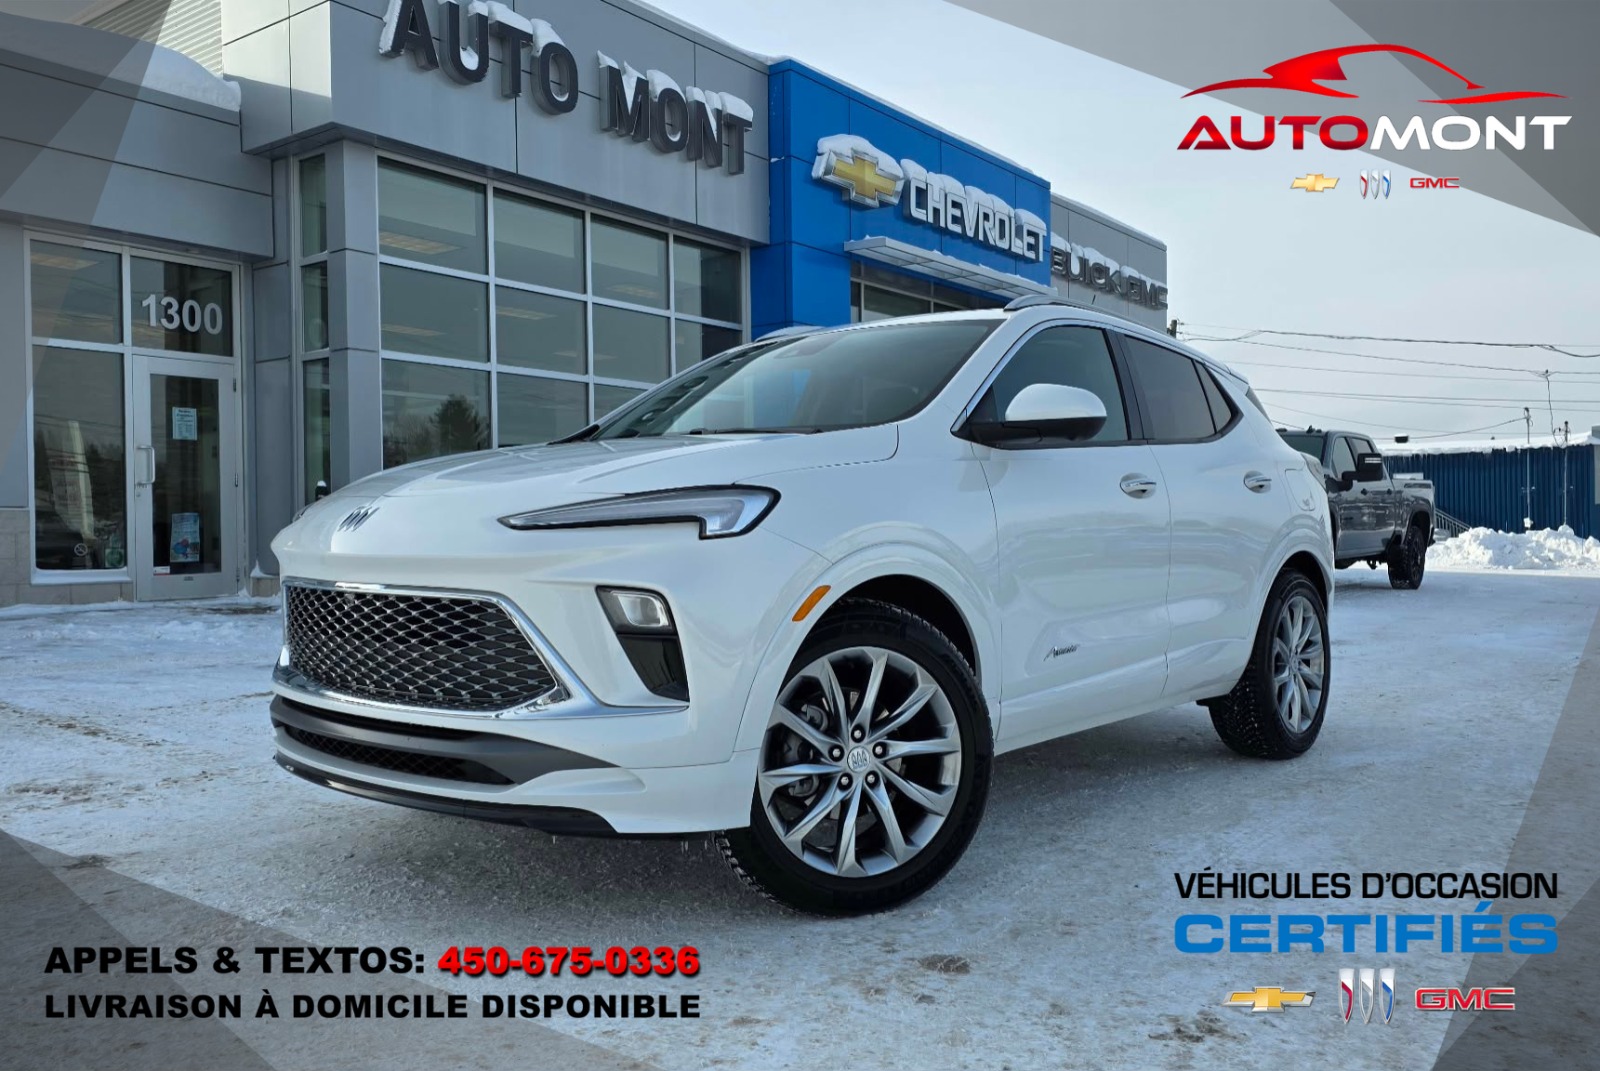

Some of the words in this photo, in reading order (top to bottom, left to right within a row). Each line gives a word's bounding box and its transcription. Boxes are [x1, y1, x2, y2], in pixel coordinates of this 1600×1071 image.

[379, 0, 579, 115] AUTO
[599, 60, 753, 175] MONT
[904, 176, 1047, 263] CHEVROLET
[142, 294, 223, 335] 1300
[1051, 246, 1120, 294] BUICK
[1120, 274, 1168, 310] GMC
